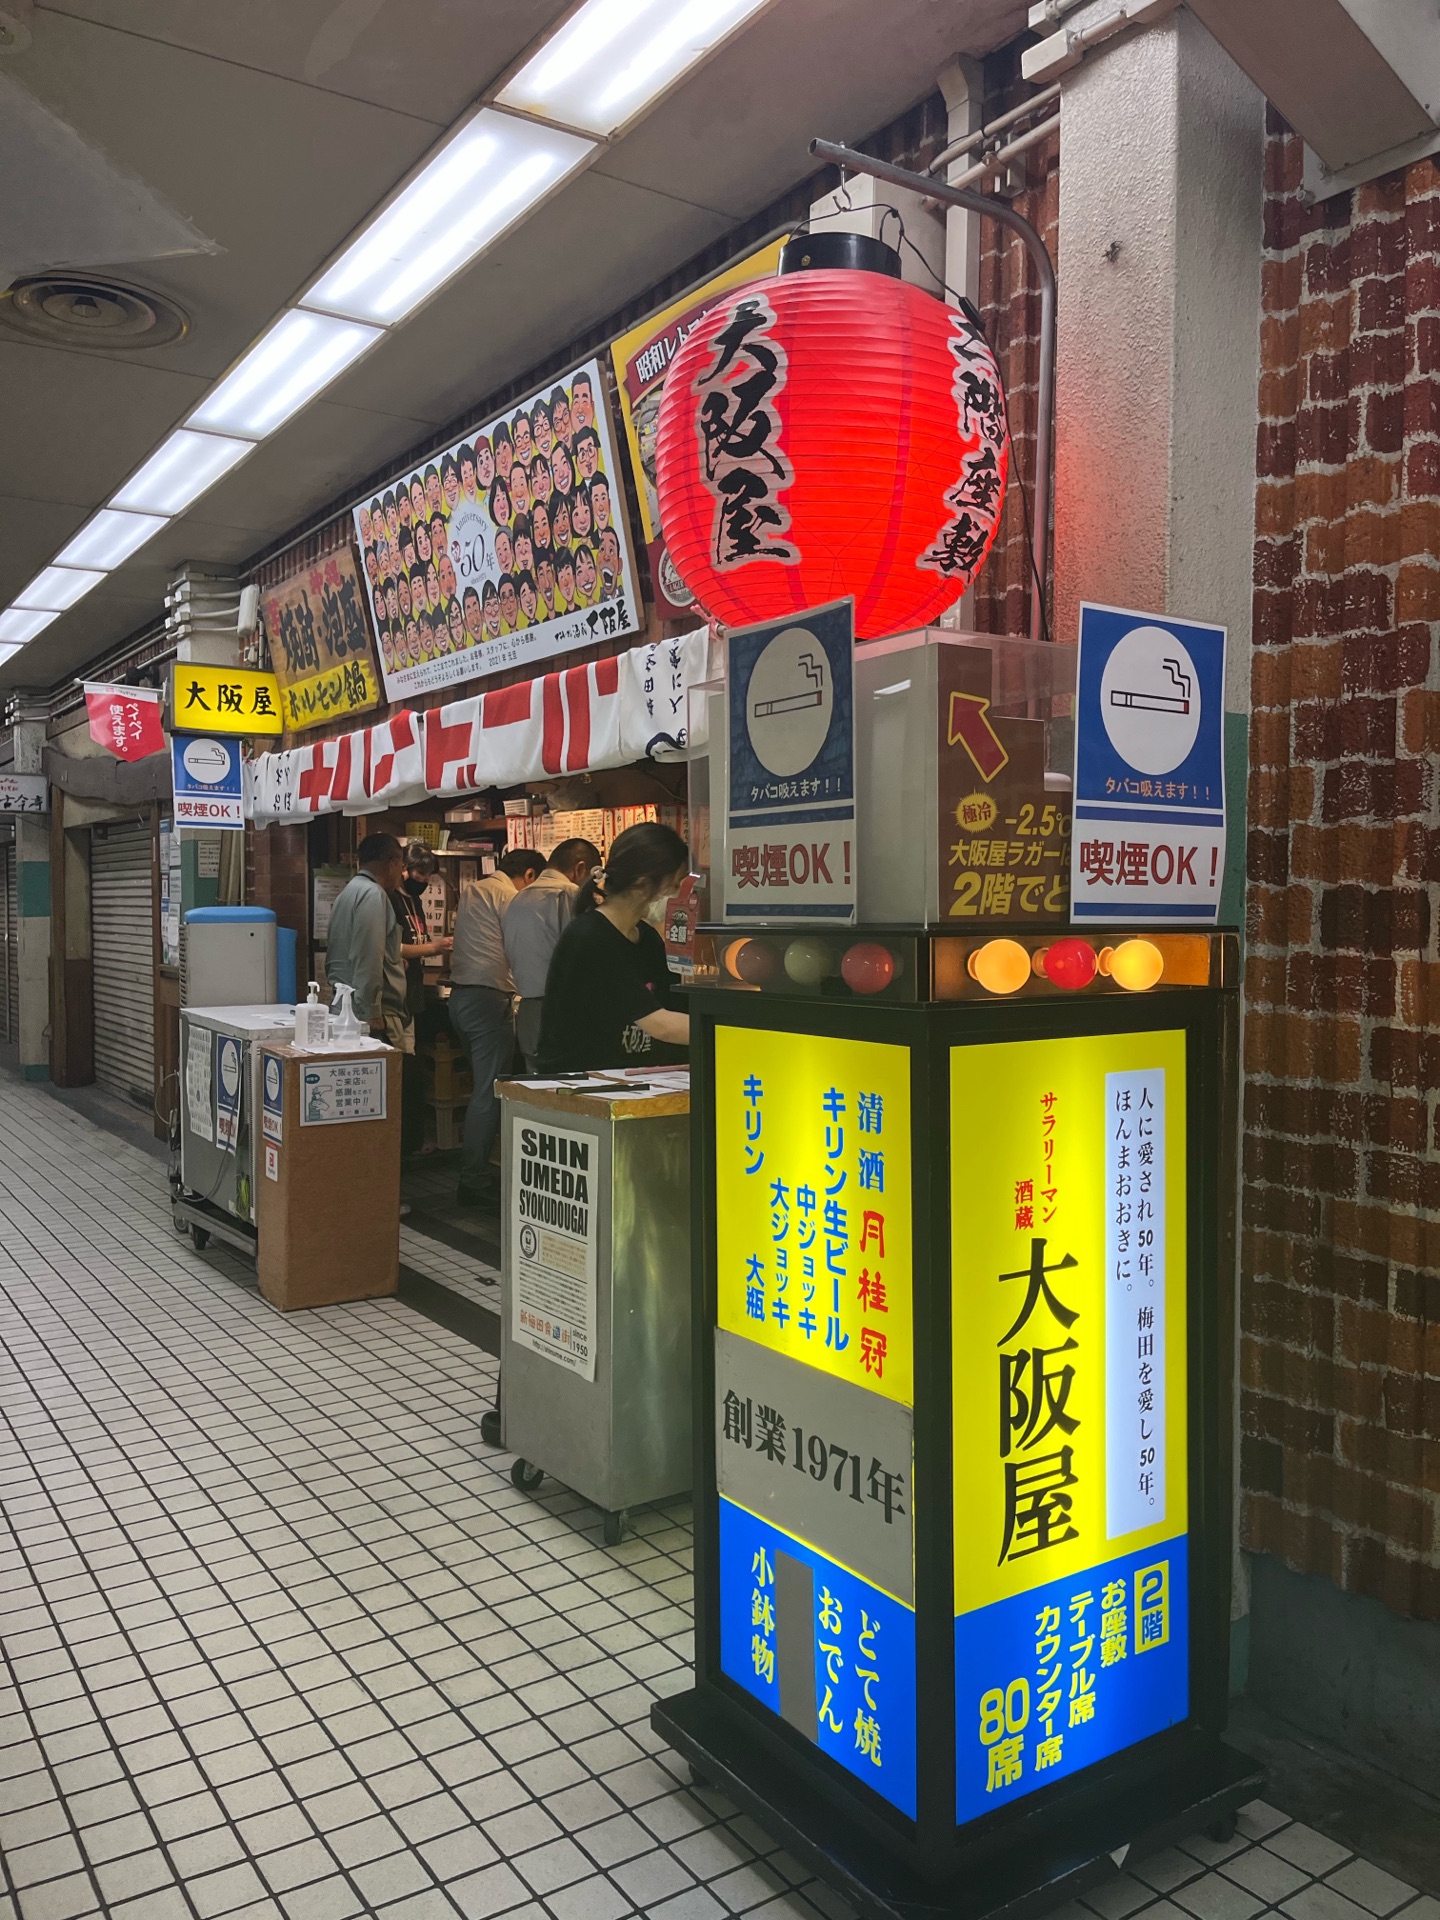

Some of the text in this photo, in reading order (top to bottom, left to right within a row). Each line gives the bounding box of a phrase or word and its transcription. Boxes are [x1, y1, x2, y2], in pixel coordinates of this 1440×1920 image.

[698, 300, 790, 565] 大阪屋
[586, 599, 631, 640] 大阪屋
[126, 703, 143, 740] ペイペイ
[184, 681, 277, 716] 大阪屋
[289, 660, 367, 721] ホルモン鍋
[110, 704, 128, 752] 使えます。
[178, 802, 240, 819] 喫煙OK！
[961, 801, 992, 825] 極冷
[732, 840, 852, 890] 喫煙OK！
[1079, 839, 1218, 888] 喫煙OK！
[520, 1158, 589, 1205] UMEDA
[521, 1128, 589, 1171] SHIN
[1040, 1091, 1059, 1225] サラリーマン
[519, 1188, 588, 1237] SYOKUDOUGAI
[743, 1073, 766, 1323] キリン 大瓶
[822, 1087, 850, 1352] キリン生ビール
[1014, 1179, 1035, 1231] 酒蔵
[1115, 1089, 1134, 1293] ほんまおおきに。
[769, 1177, 791, 1330] 大ジョッキ
[796, 1183, 818, 1340] 中ジョッキ
[520, 1309, 570, 1345] 新梅田食道街
[572, 1328, 588, 1342] since
[572, 1341, 588, 1357] 1950
[997, 1238, 1082, 1567] 大阪屋
[722, 1389, 906, 1525] 創業1971年
[750, 1545, 775, 1686] 小鉢物
[1100, 1577, 1127, 1669] お座敷
[1141, 1568, 1165, 1646] 2階
[818, 1585, 844, 1735] おでん
[853, 1608, 883, 1768] どて焼
[1034, 1604, 1063, 1773] カウンター席
[1067, 1589, 1097, 1727] テーブル席
